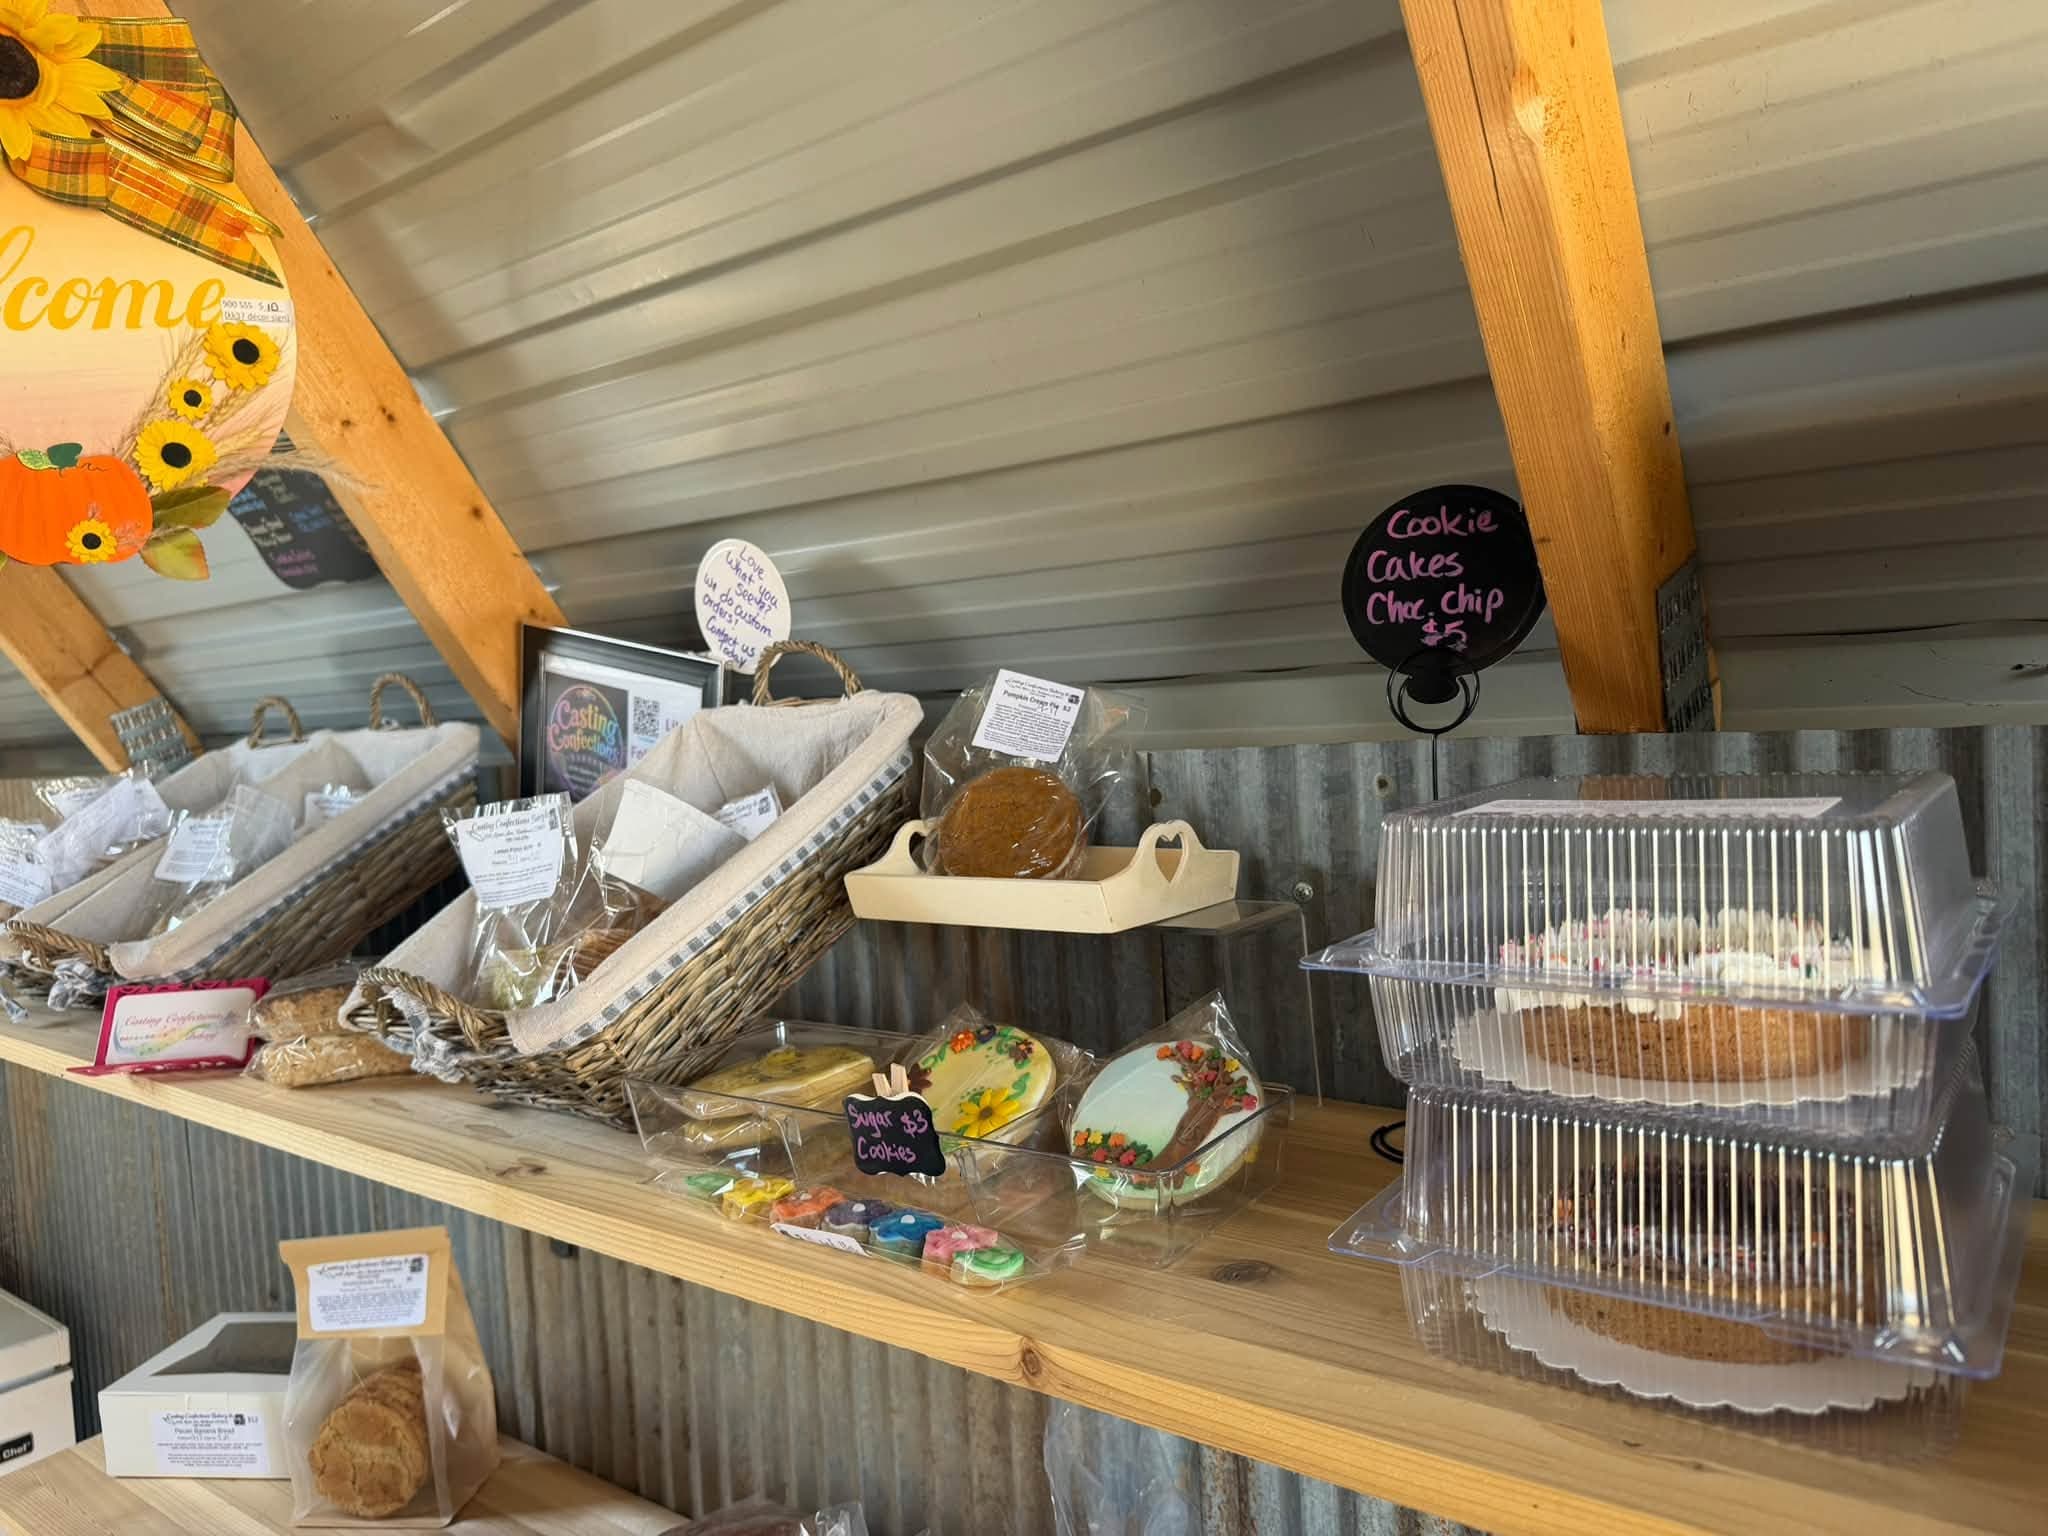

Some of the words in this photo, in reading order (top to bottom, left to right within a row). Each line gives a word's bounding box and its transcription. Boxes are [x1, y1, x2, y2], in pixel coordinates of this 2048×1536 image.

[1386, 505, 1499, 539] Cookie
[1367, 550, 1465, 583] Cakes
[1420, 617, 1468, 651] $5
[557, 699, 617, 746] Casting
[848, 1104, 893, 1138] Sugar
[900, 1109, 929, 1138] $3
[857, 1136, 917, 1163] Cookies
[2, 1443, 27, 1459] Chef
